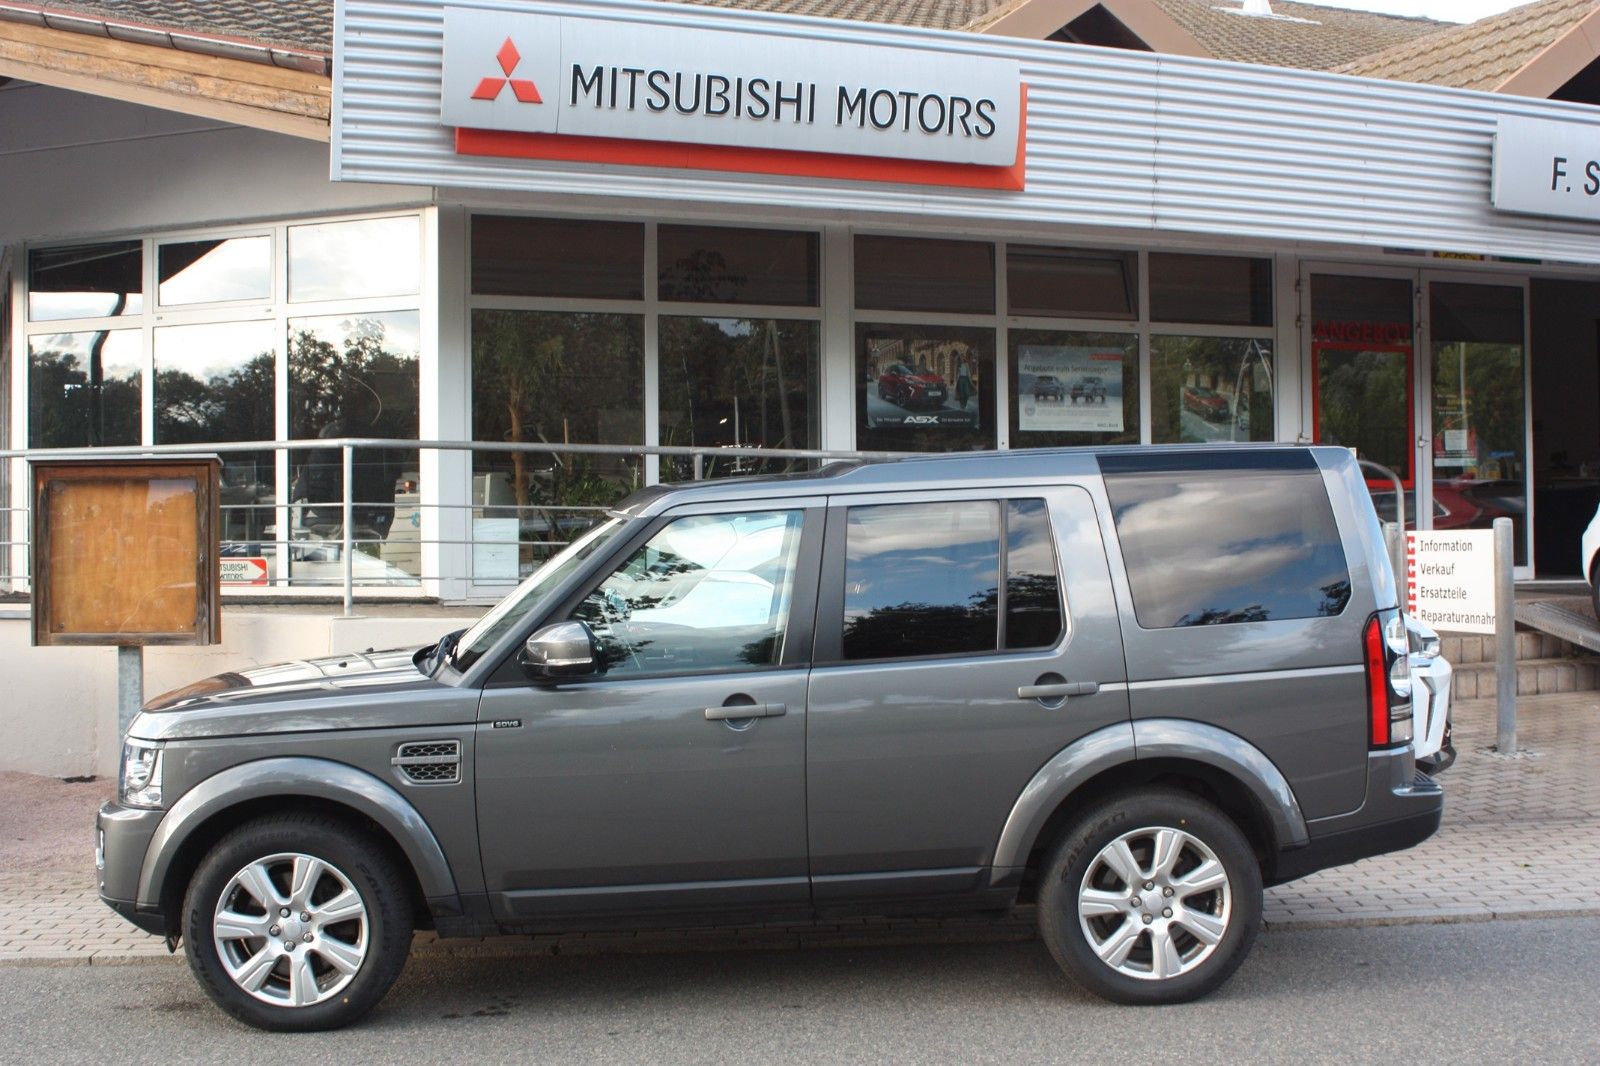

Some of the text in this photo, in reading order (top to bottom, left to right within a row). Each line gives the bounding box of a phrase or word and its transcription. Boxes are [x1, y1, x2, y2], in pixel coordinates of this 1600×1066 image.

[569, 63, 998, 139] MITSUBISHI MOTORS
[1551, 156, 1571, 193] F.
[1312, 319, 1410, 342] ANGEBOT
[903, 415, 939, 424] ASX
[1420, 540, 1472, 552] Information
[1420, 563, 1455, 575] Verkauf
[1420, 586, 1467, 599] Ersatzteile
